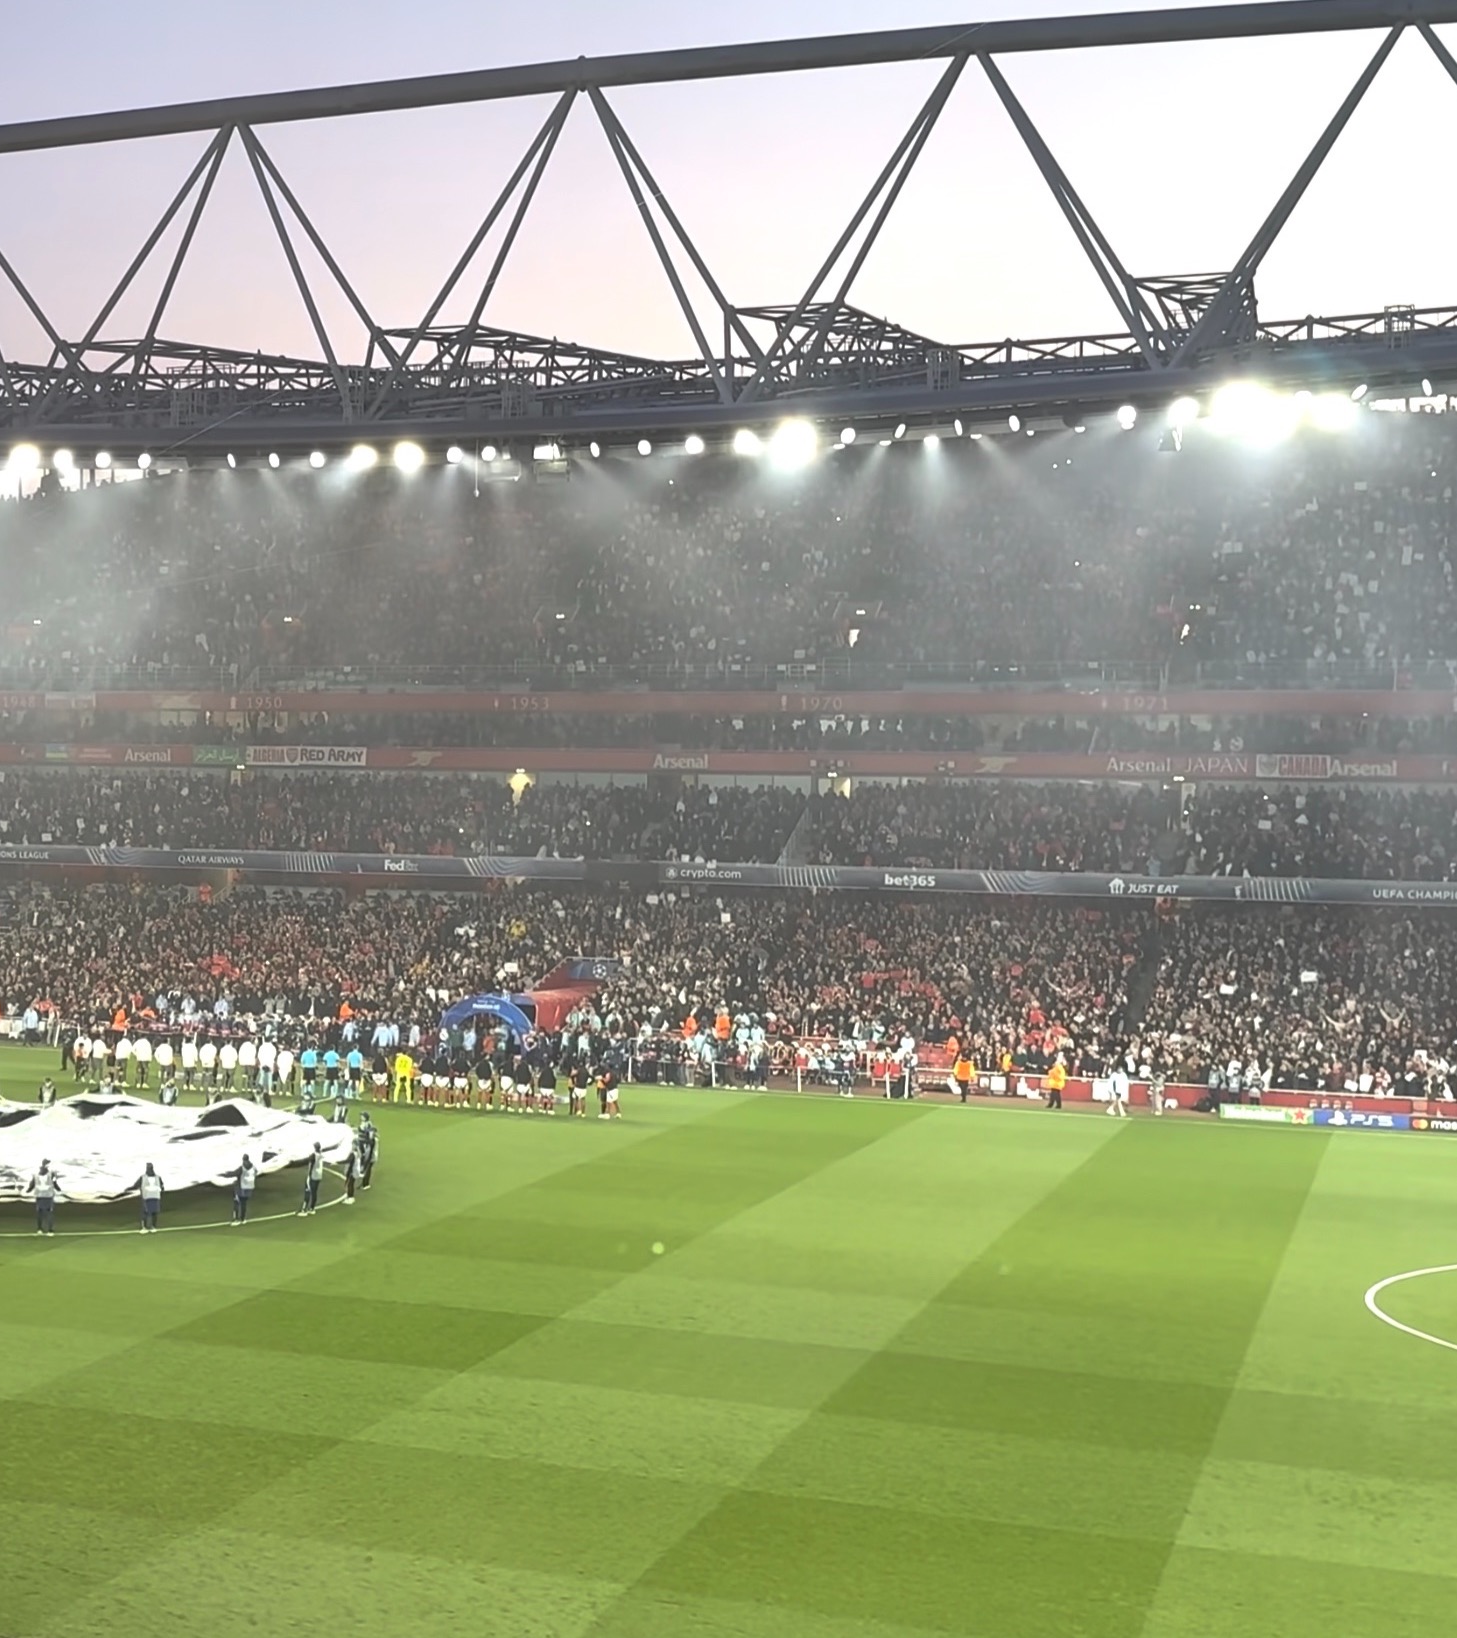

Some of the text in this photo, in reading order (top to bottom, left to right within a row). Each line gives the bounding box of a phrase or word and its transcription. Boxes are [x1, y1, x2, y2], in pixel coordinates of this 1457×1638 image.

[247, 696, 282, 709] 1950
[511, 697, 549, 709] 1953
[801, 697, 842, 710] 1970
[1123, 696, 1168, 710] 1971
[124, 748, 171, 762] Arsenal
[253, 748, 364, 763] ALGERIA RED ARMY
[653, 753, 708, 769] Arsenal
[1106, 757, 1248, 773] Arsenal JAPAN
[1279, 755, 1329, 777] CANADA
[1329, 760, 1397, 776] Arsenal
[19, 851, 49, 860] LEAGUE
[178, 855, 244, 865] QATAR AIRWAYS
[384, 860, 418, 871] FedEx
[680, 868, 742, 879] crypto.com
[884, 873, 936, 887] bet365
[1127, 883, 1179, 894] JUST EAT
[1372, 888, 1404, 899] UEFA
[1350, 1113, 1394, 1127] PS5
